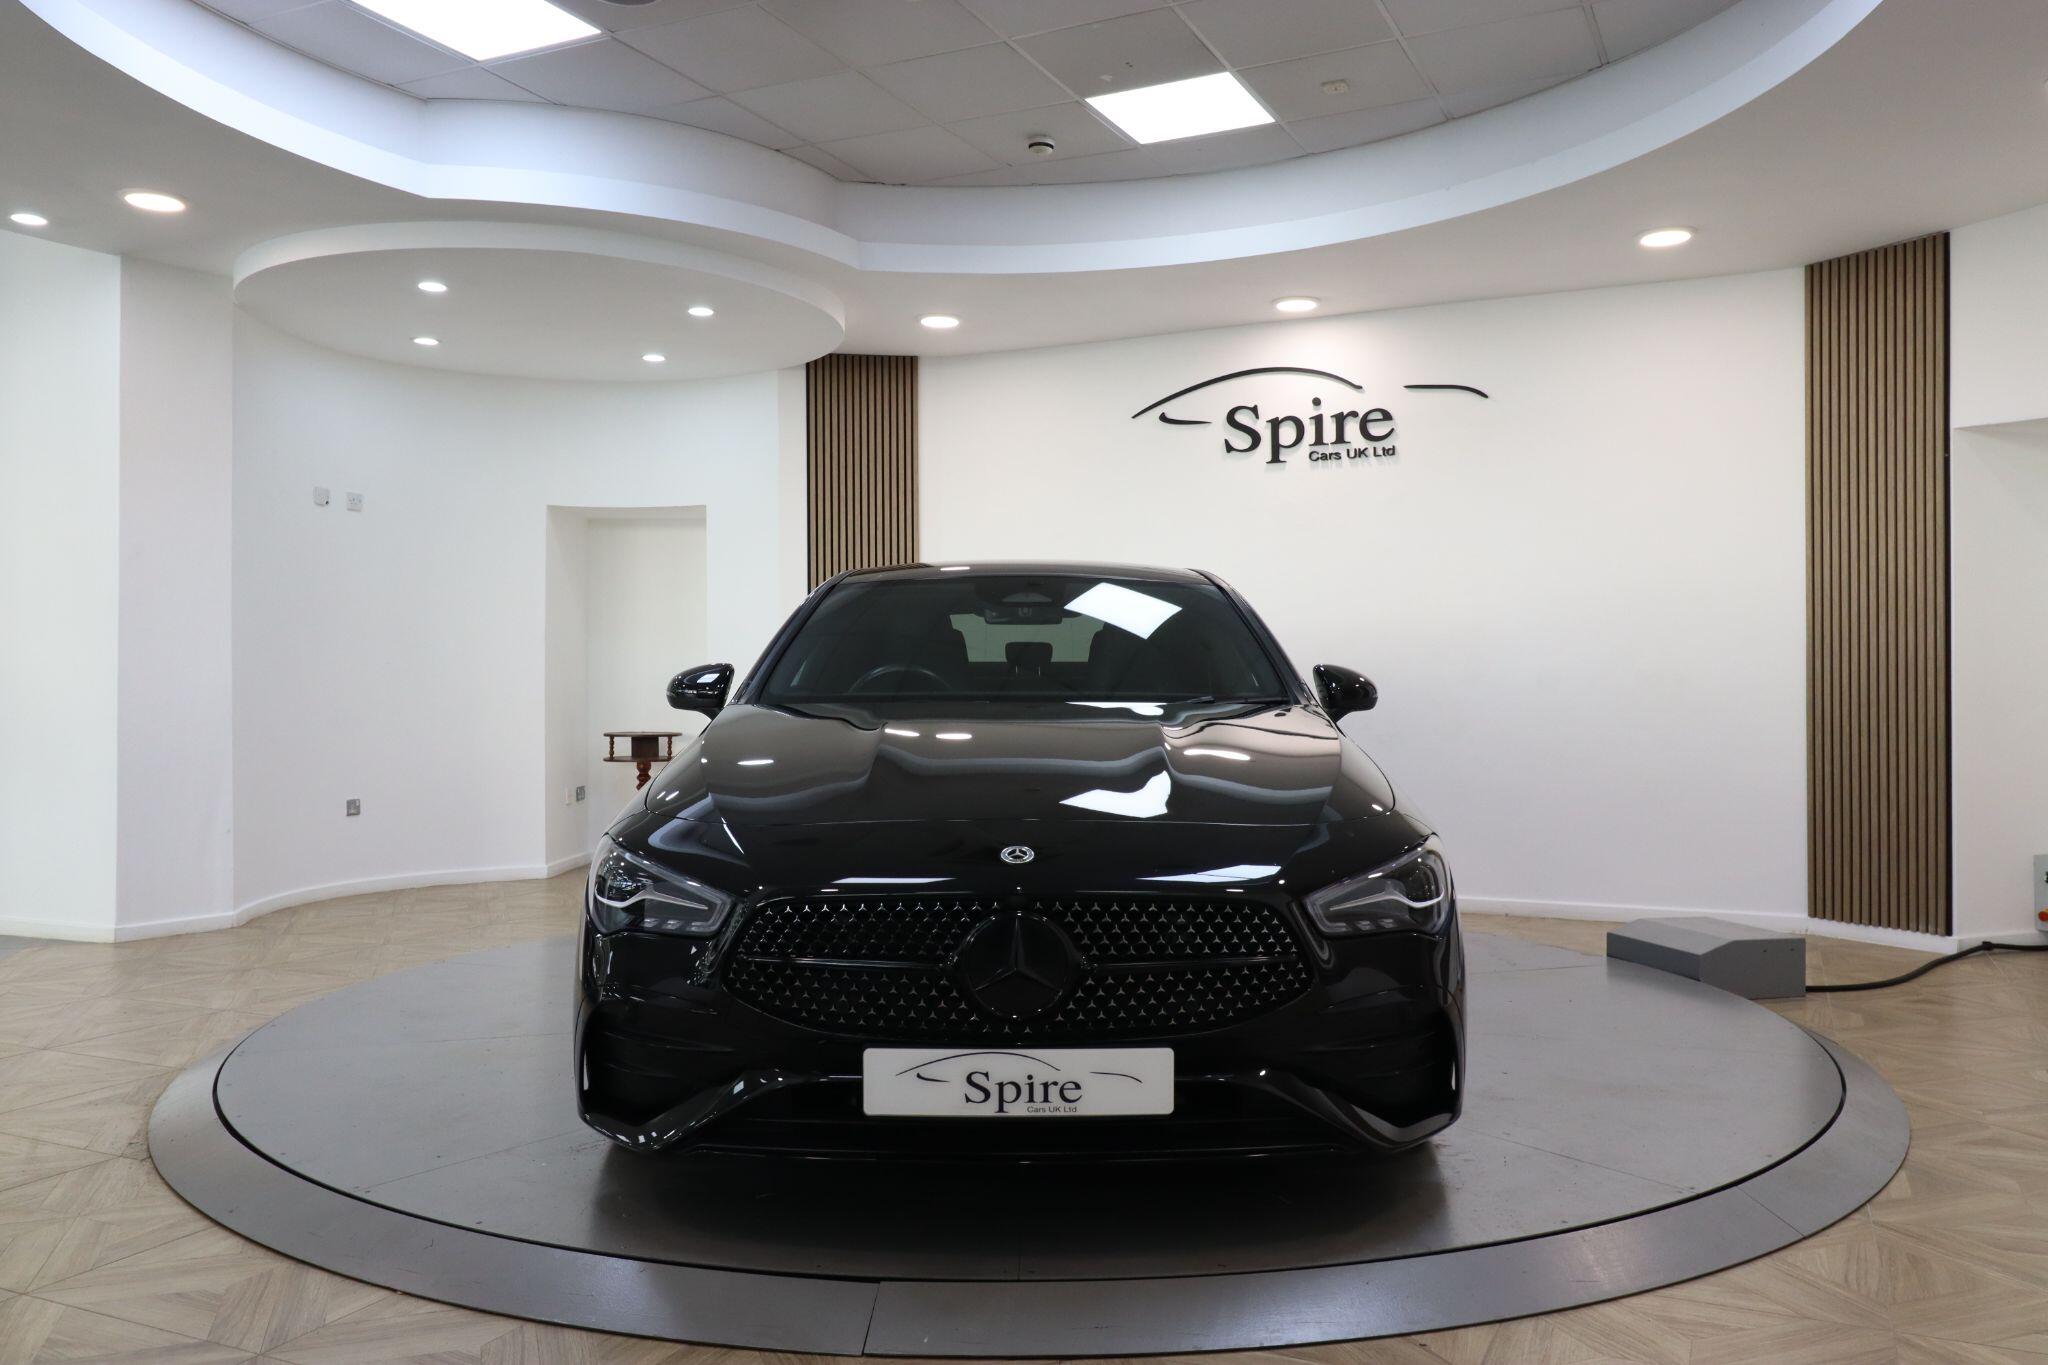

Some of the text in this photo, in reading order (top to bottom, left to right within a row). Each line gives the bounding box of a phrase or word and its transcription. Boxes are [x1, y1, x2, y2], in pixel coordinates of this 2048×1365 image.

[1224, 397, 1395, 464] Spire
[1308, 445, 1396, 462] Cars UK Ltd
[964, 1071, 1083, 1113] Spire
[1026, 1105, 1046, 1113] Cars
[1063, 1105, 1077, 1113] Ltd
